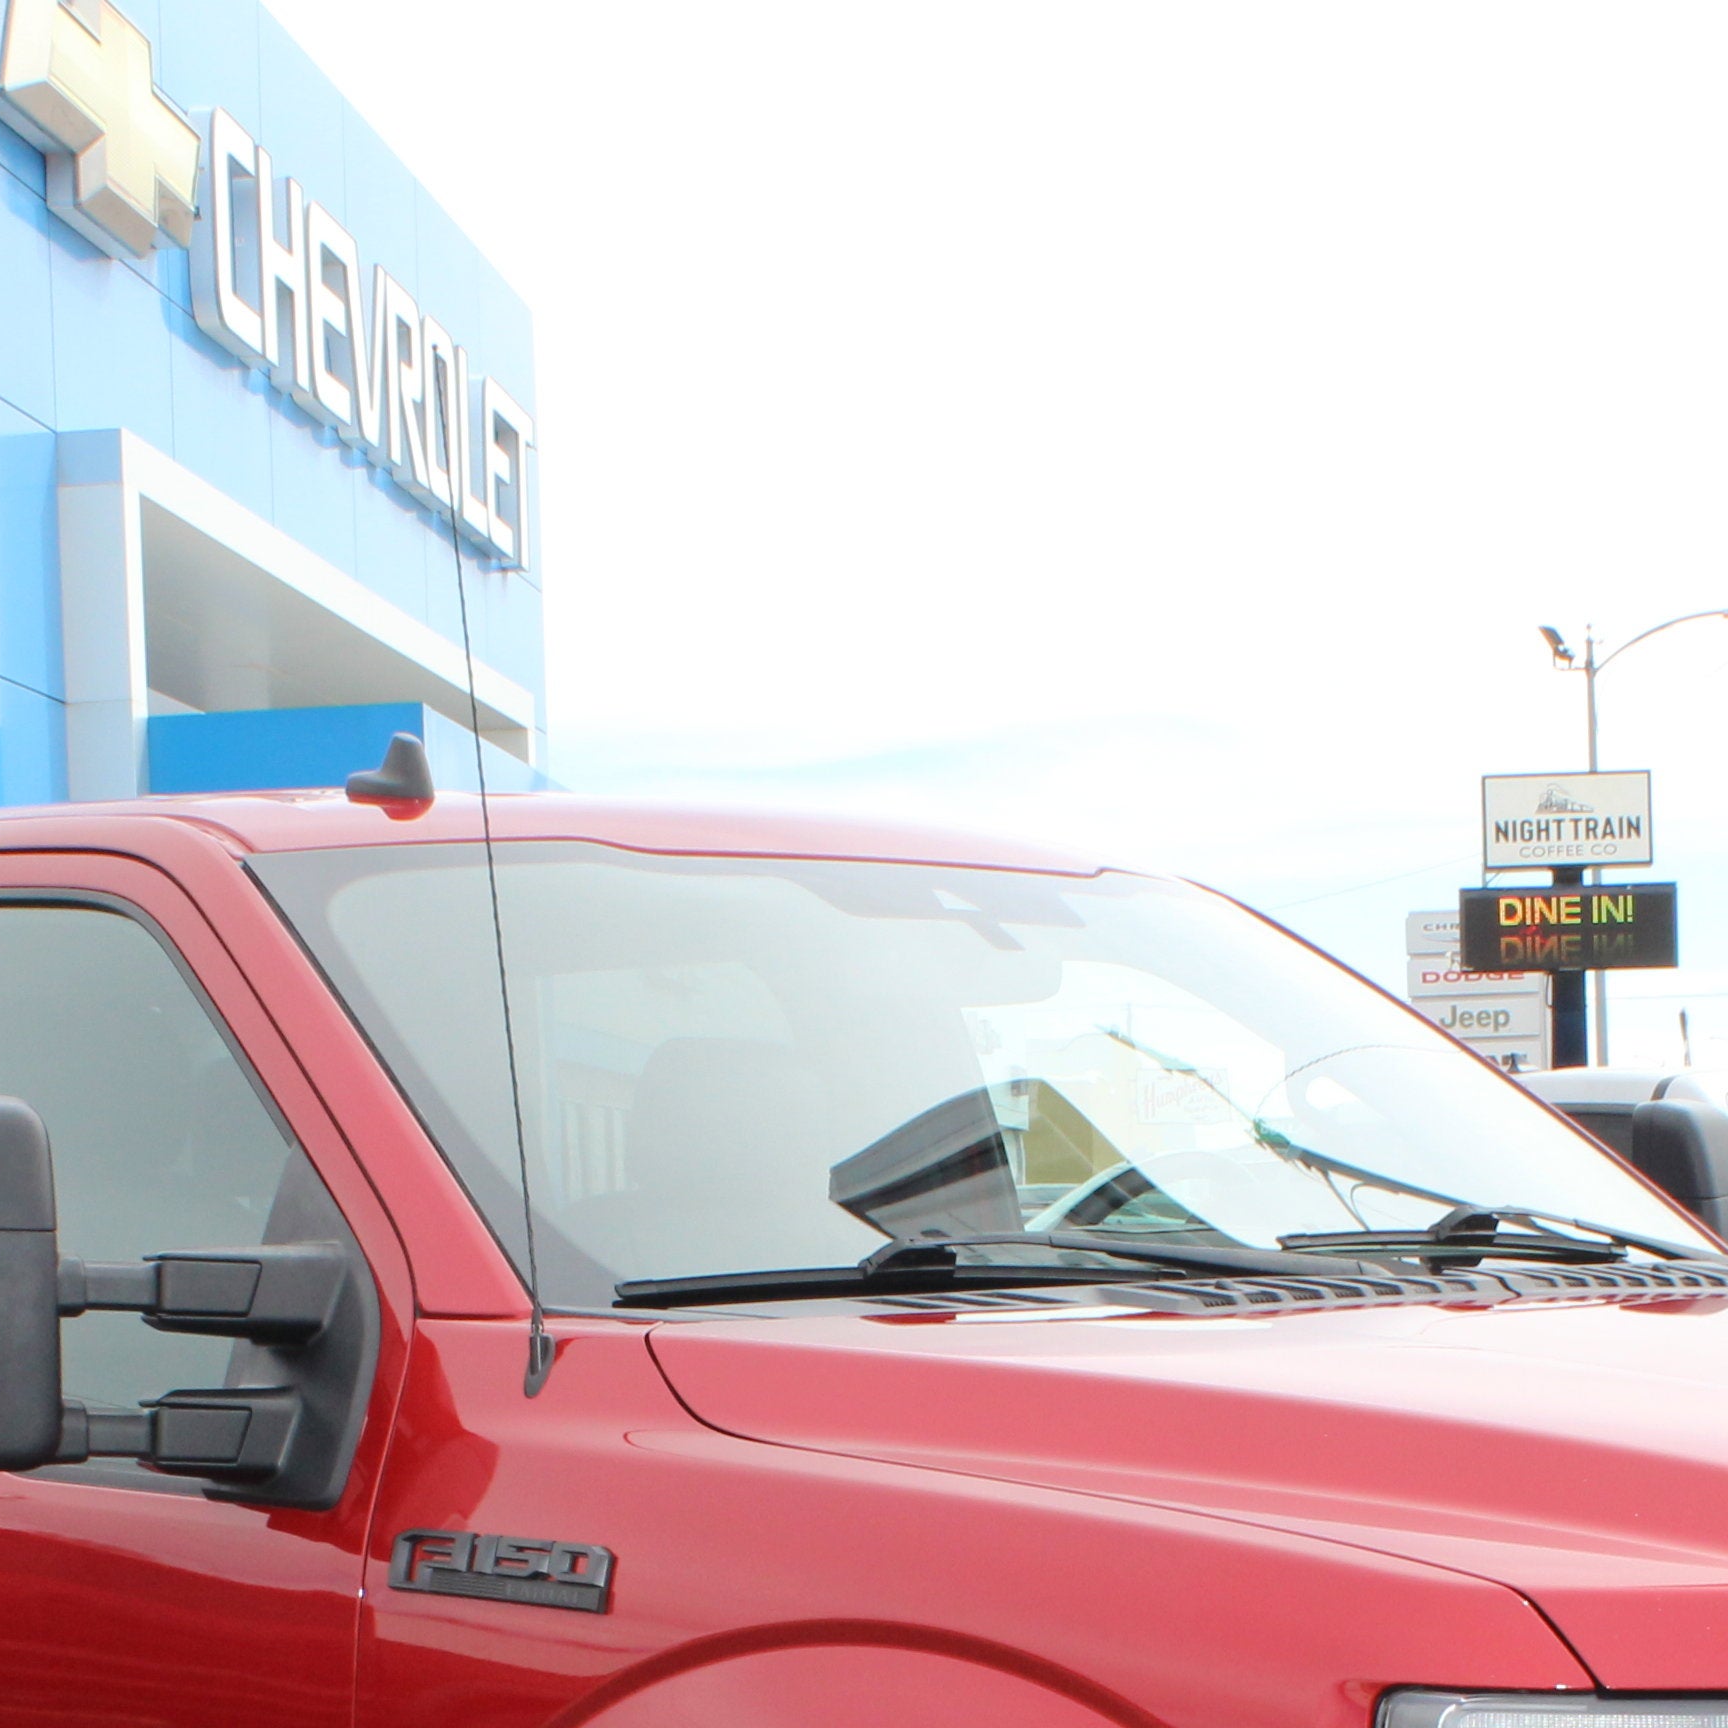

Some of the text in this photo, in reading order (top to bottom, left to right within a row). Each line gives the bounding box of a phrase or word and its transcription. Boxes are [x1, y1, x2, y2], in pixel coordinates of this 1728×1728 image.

[188, 106, 536, 572] CHEVROLET
[1494, 815, 1642, 844] NIGHT TRAIN
[1519, 843, 1618, 859] COFFEE CO
[1498, 894, 1634, 927] DINE IN!
[1422, 971, 1525, 984] DODGE
[1440, 1005, 1511, 1032] Jeep
